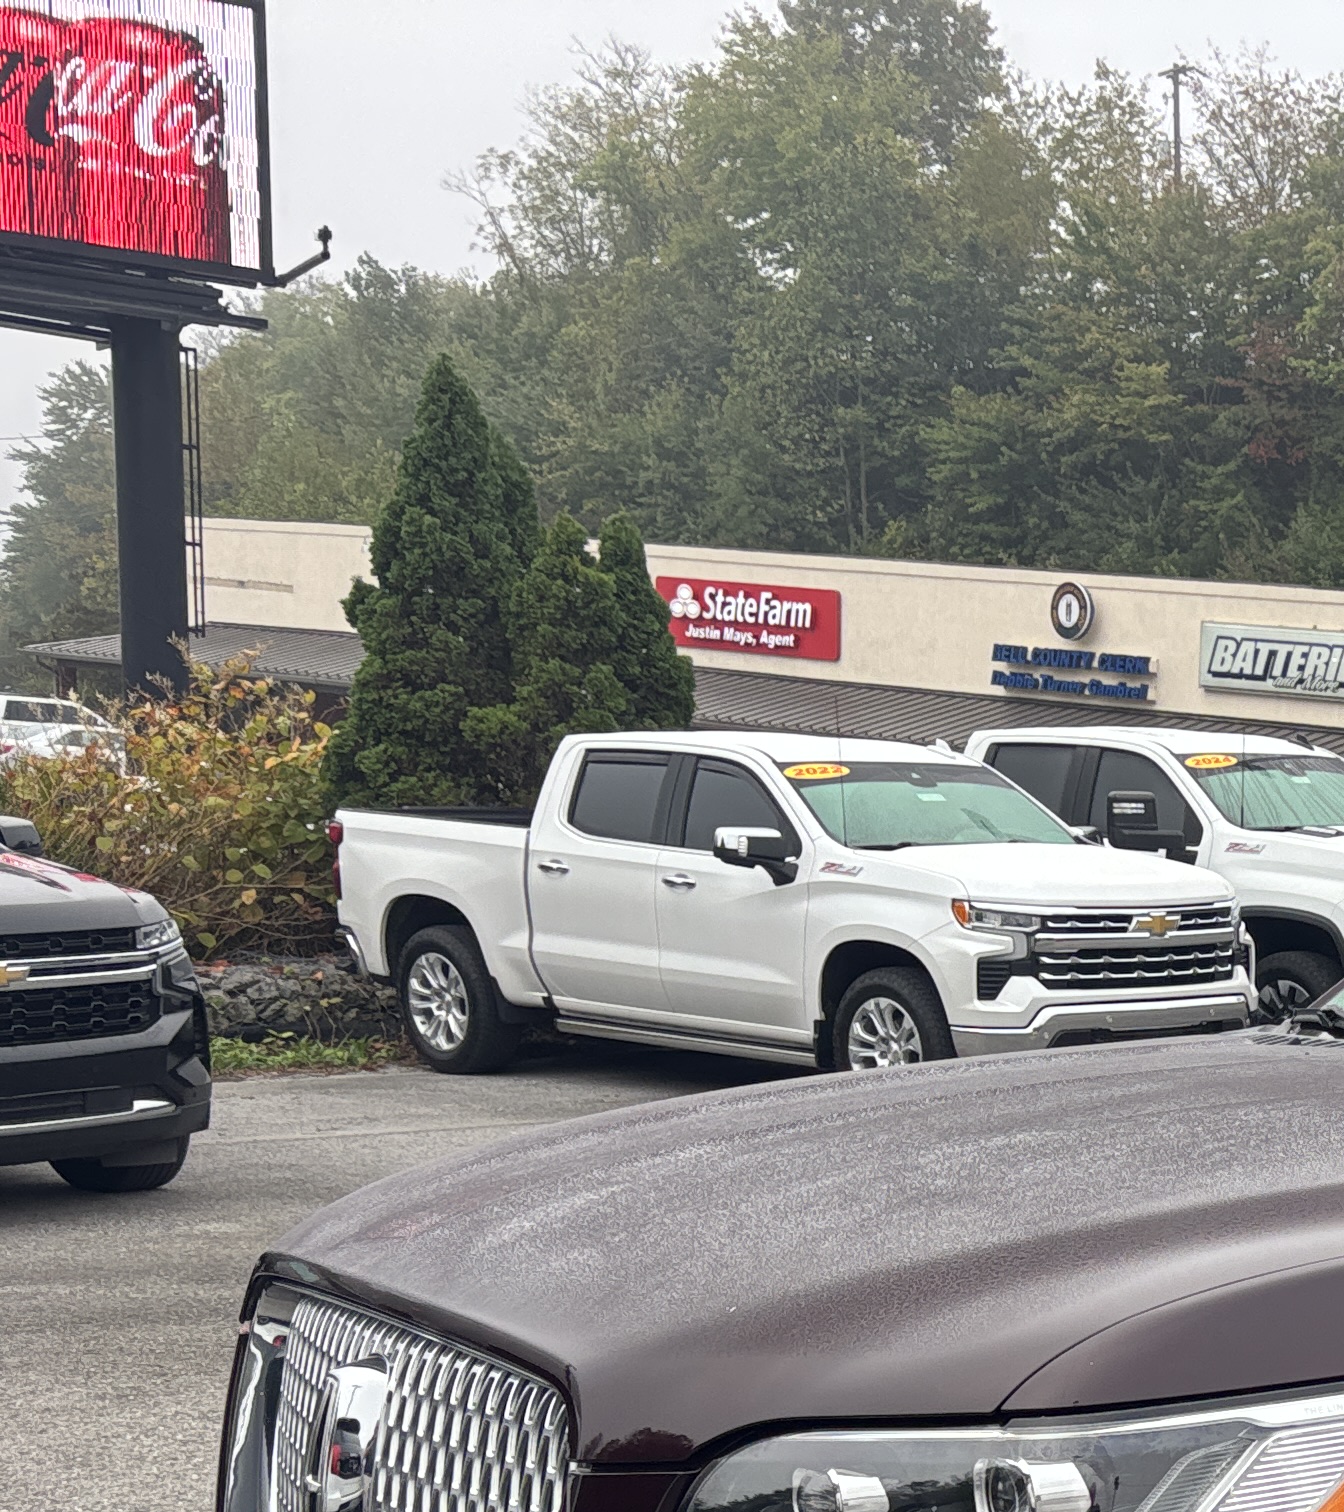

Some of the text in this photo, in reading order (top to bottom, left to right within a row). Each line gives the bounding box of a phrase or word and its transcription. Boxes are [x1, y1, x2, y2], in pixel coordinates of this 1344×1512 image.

[685, 623, 796, 648] Justin Mays, Agent
[1031, 647, 1095, 670] COUNTY
[1098, 653, 1151, 674] CLERK
[1272, 672, 1341, 694] and More
[793, 766, 844, 777] 2022
[1192, 756, 1233, 766] 2024
